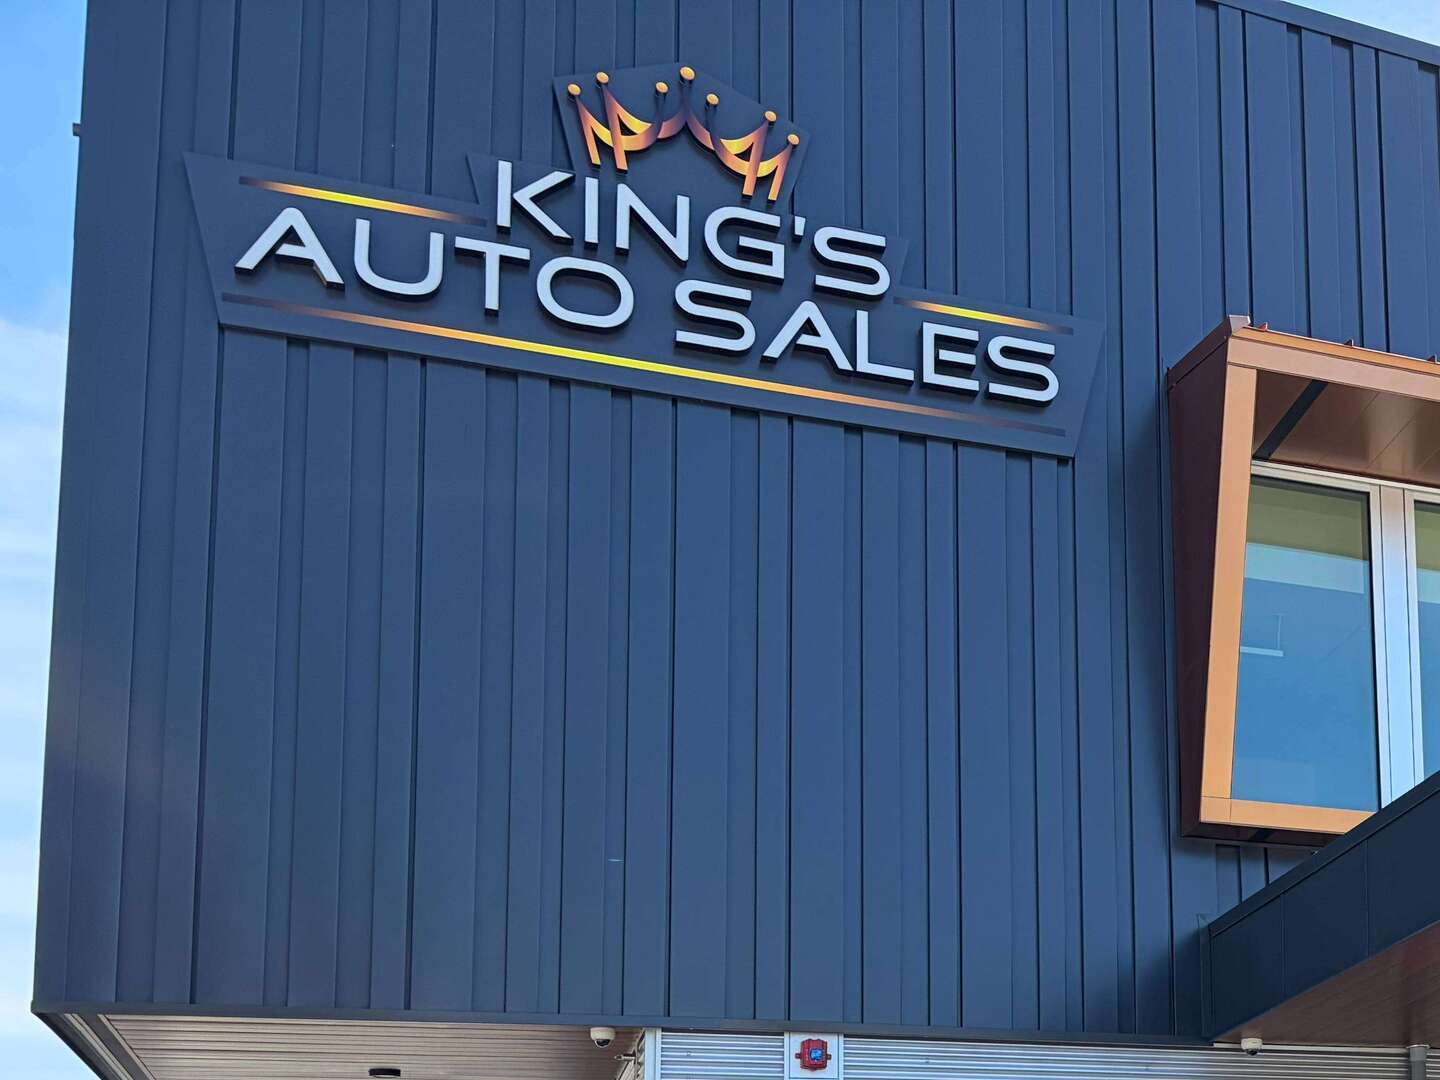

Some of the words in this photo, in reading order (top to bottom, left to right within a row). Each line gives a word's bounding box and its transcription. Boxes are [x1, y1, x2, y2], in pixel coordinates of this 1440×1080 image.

[235, 207, 635, 329] AUTO
[674, 279, 1060, 403] SALES
[496, 160, 892, 298] KING'S
